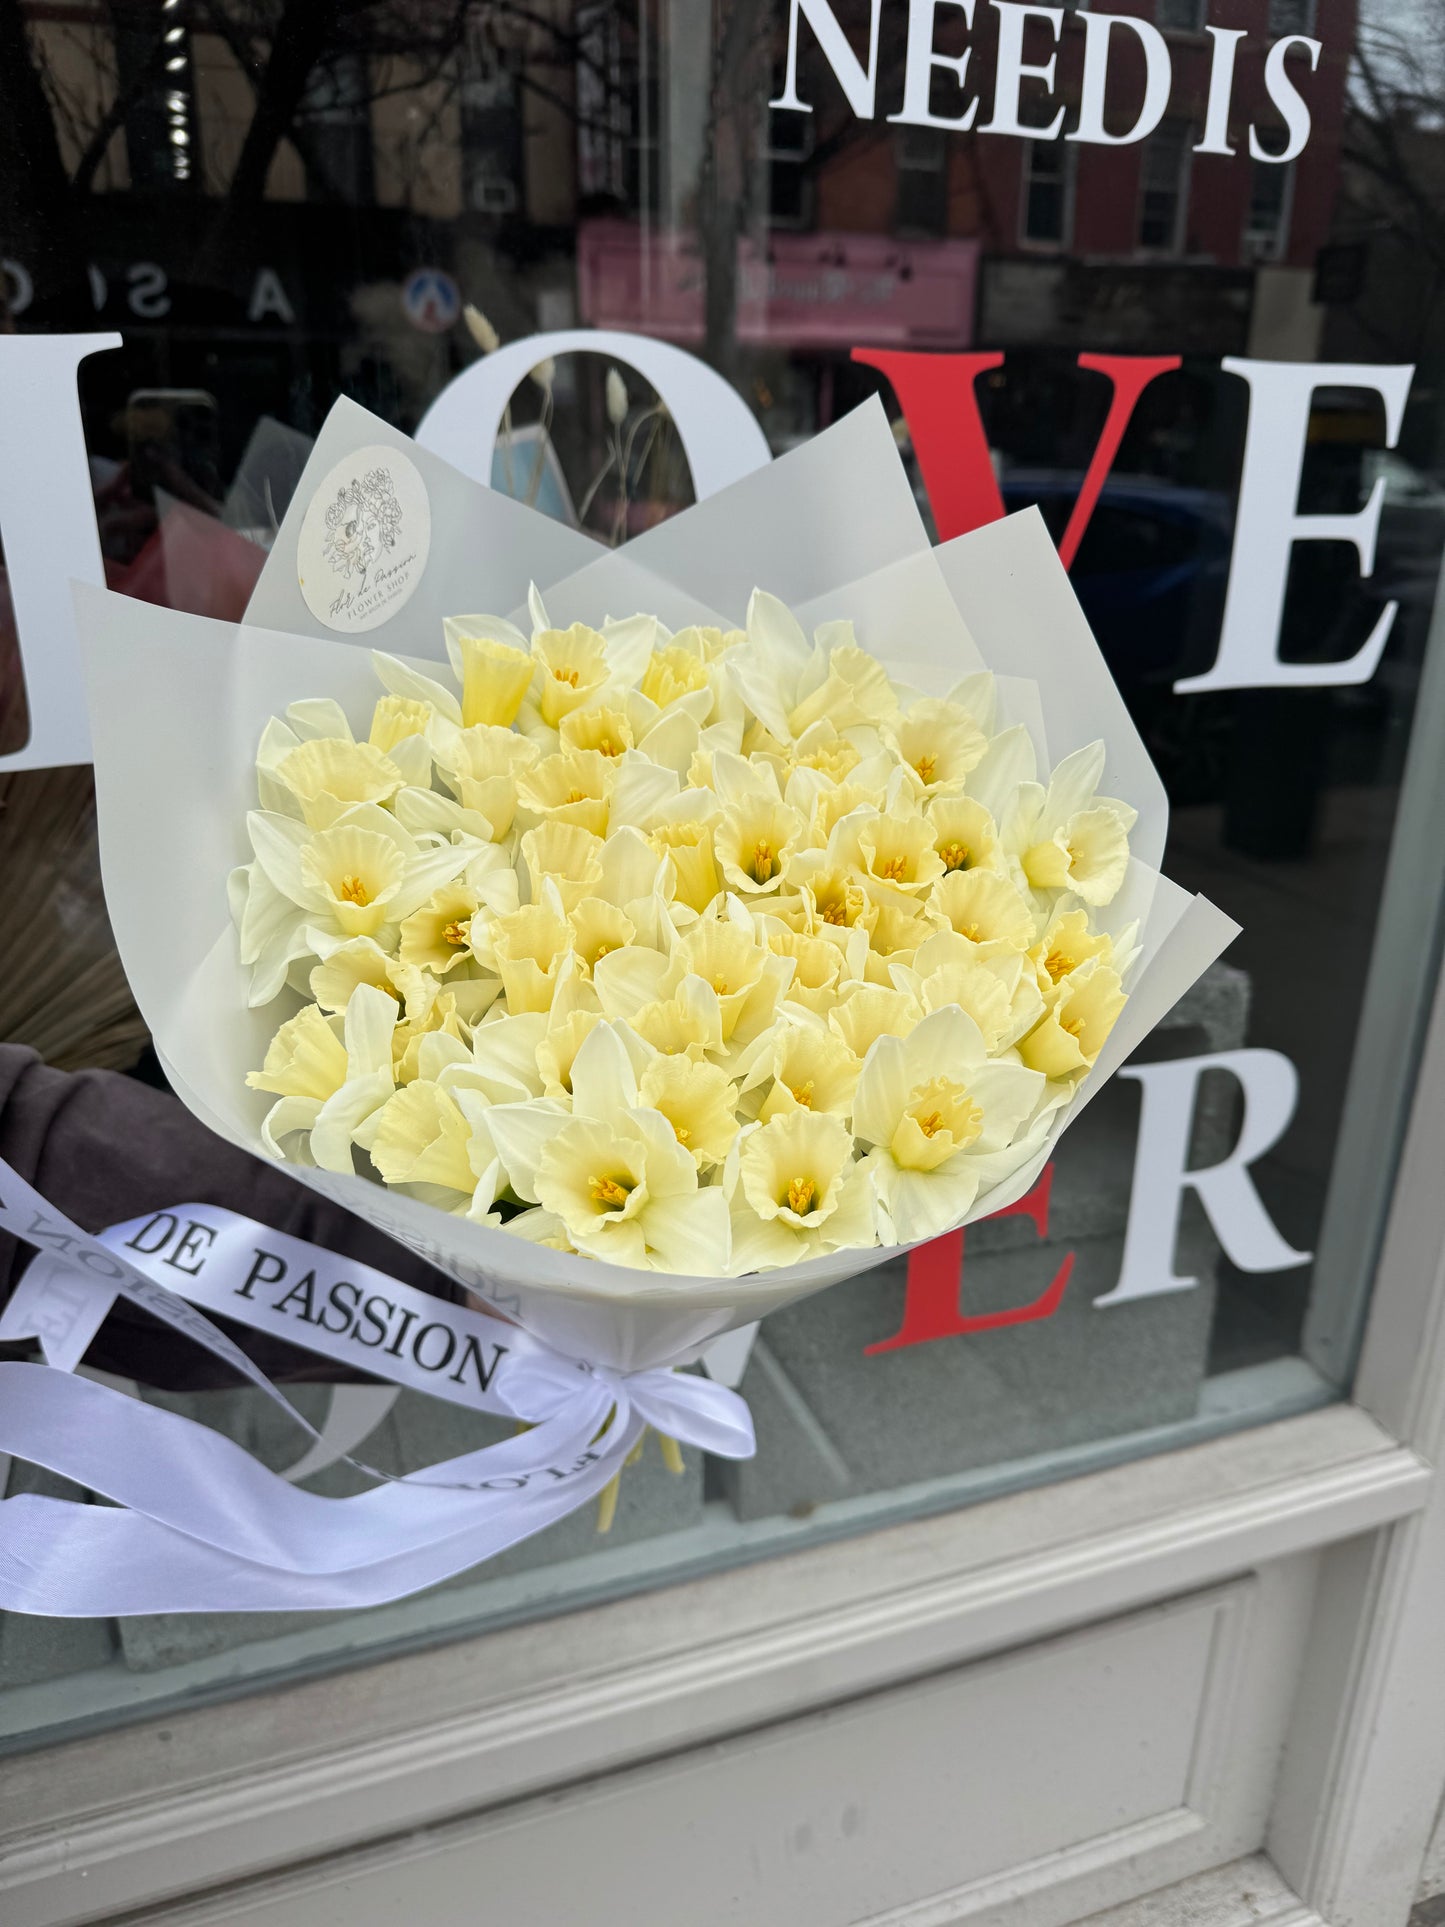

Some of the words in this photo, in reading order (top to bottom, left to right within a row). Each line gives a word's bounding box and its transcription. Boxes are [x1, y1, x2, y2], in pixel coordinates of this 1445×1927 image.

[768, 0, 1172, 146] NEED
[1193, 26, 1322, 163] IS
[347, 590, 384, 620] FLOWER
[386, 571, 410, 593] SHOP
[125, 1212, 219, 1277] DE
[234, 1247, 510, 1393] PASSION
